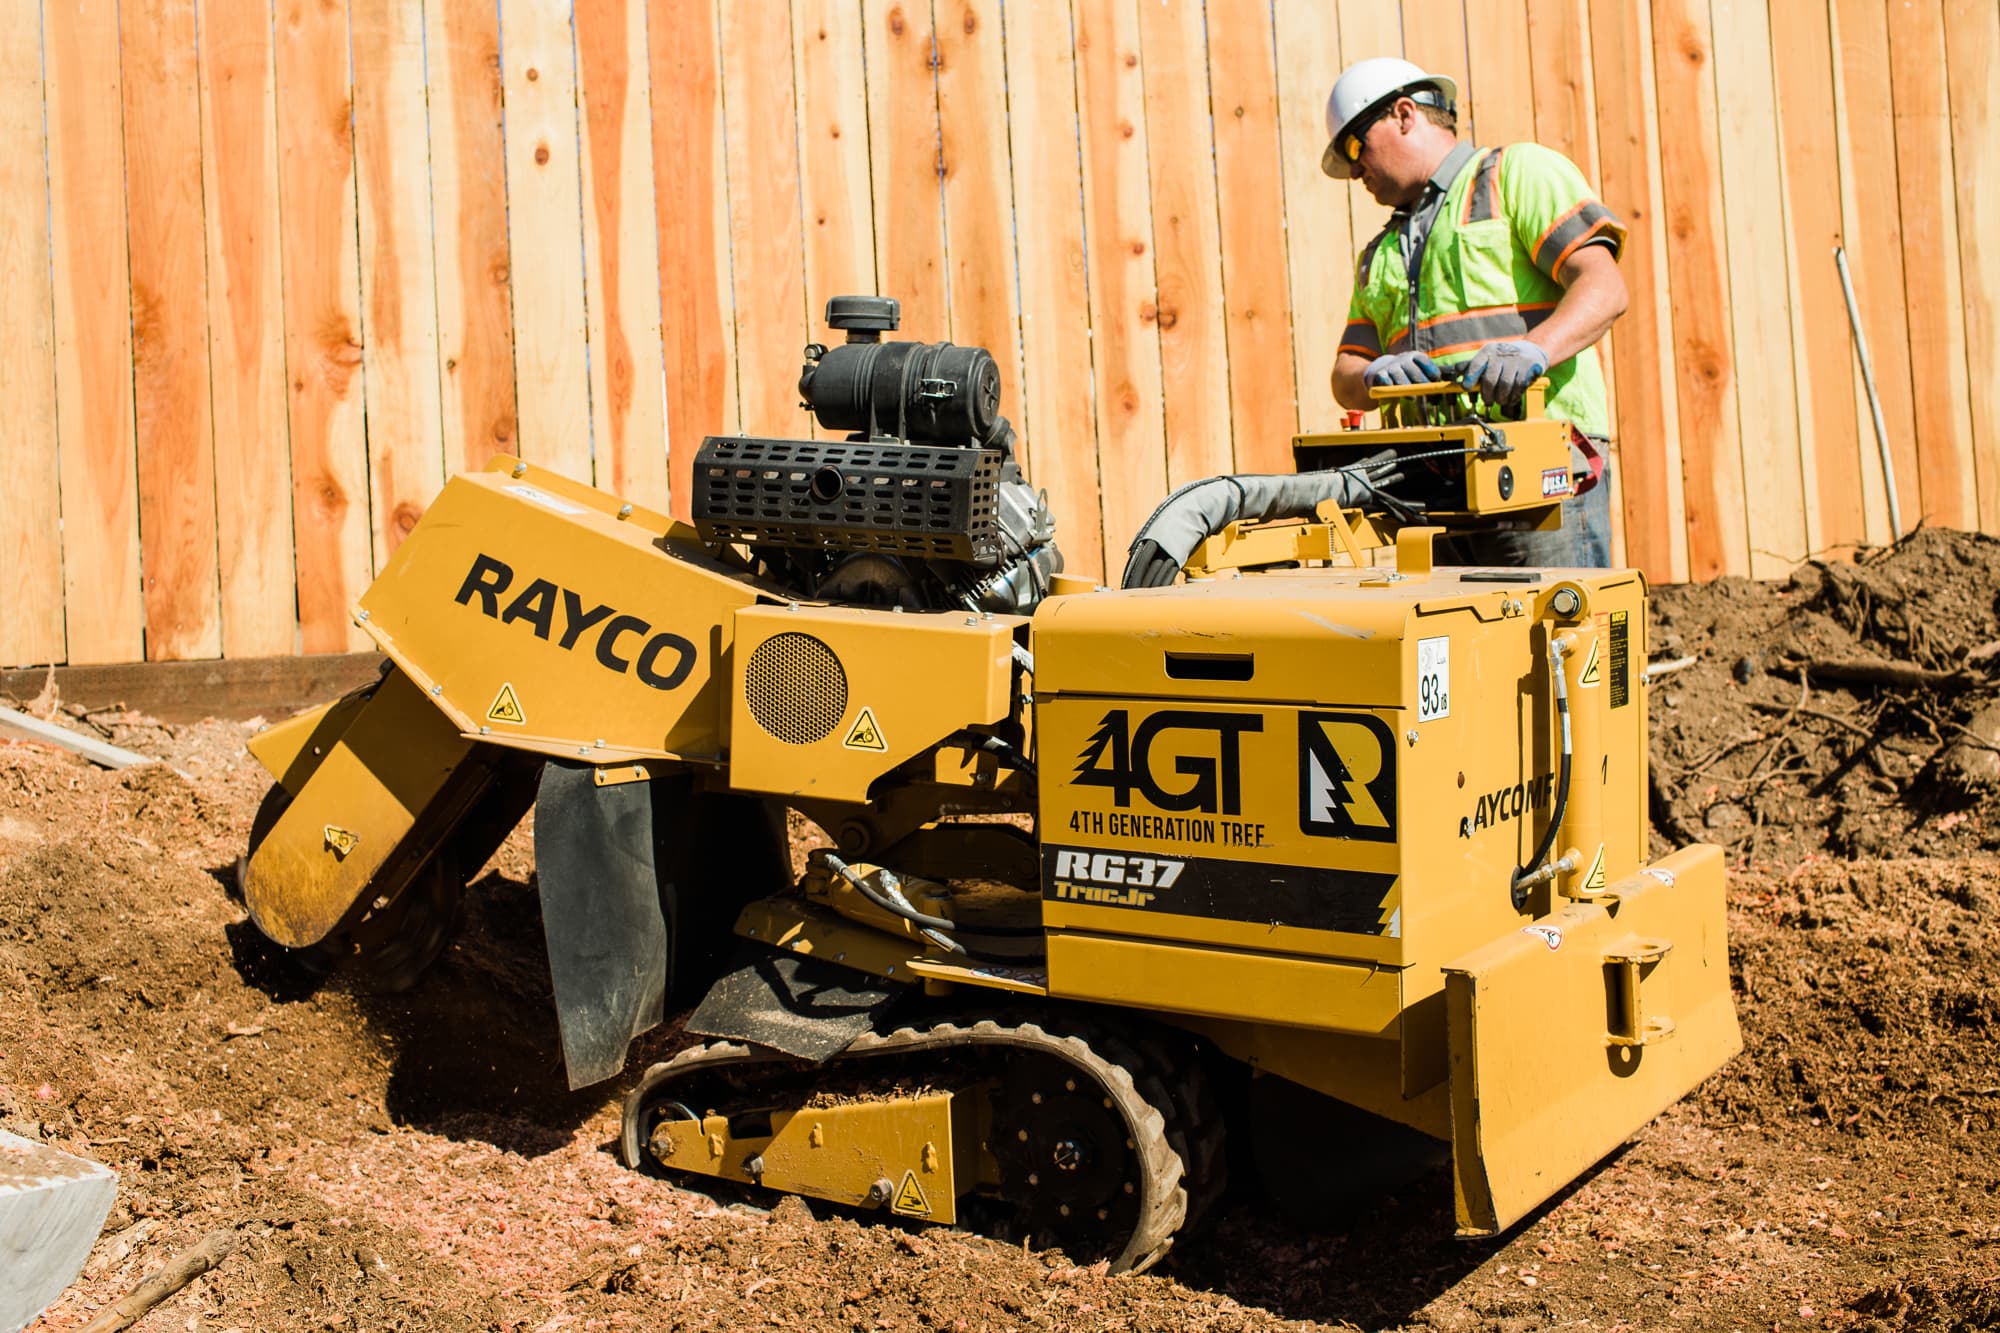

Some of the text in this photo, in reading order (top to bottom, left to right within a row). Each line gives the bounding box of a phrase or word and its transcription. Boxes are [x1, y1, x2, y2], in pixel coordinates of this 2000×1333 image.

[454, 553, 697, 690] RAYCO
[1421, 673, 1439, 716] 93
[1069, 709, 1264, 816] 4GT
[1069, 810, 1265, 846] 4TH GENERATION TREE
[1055, 850, 1185, 889] RG37
